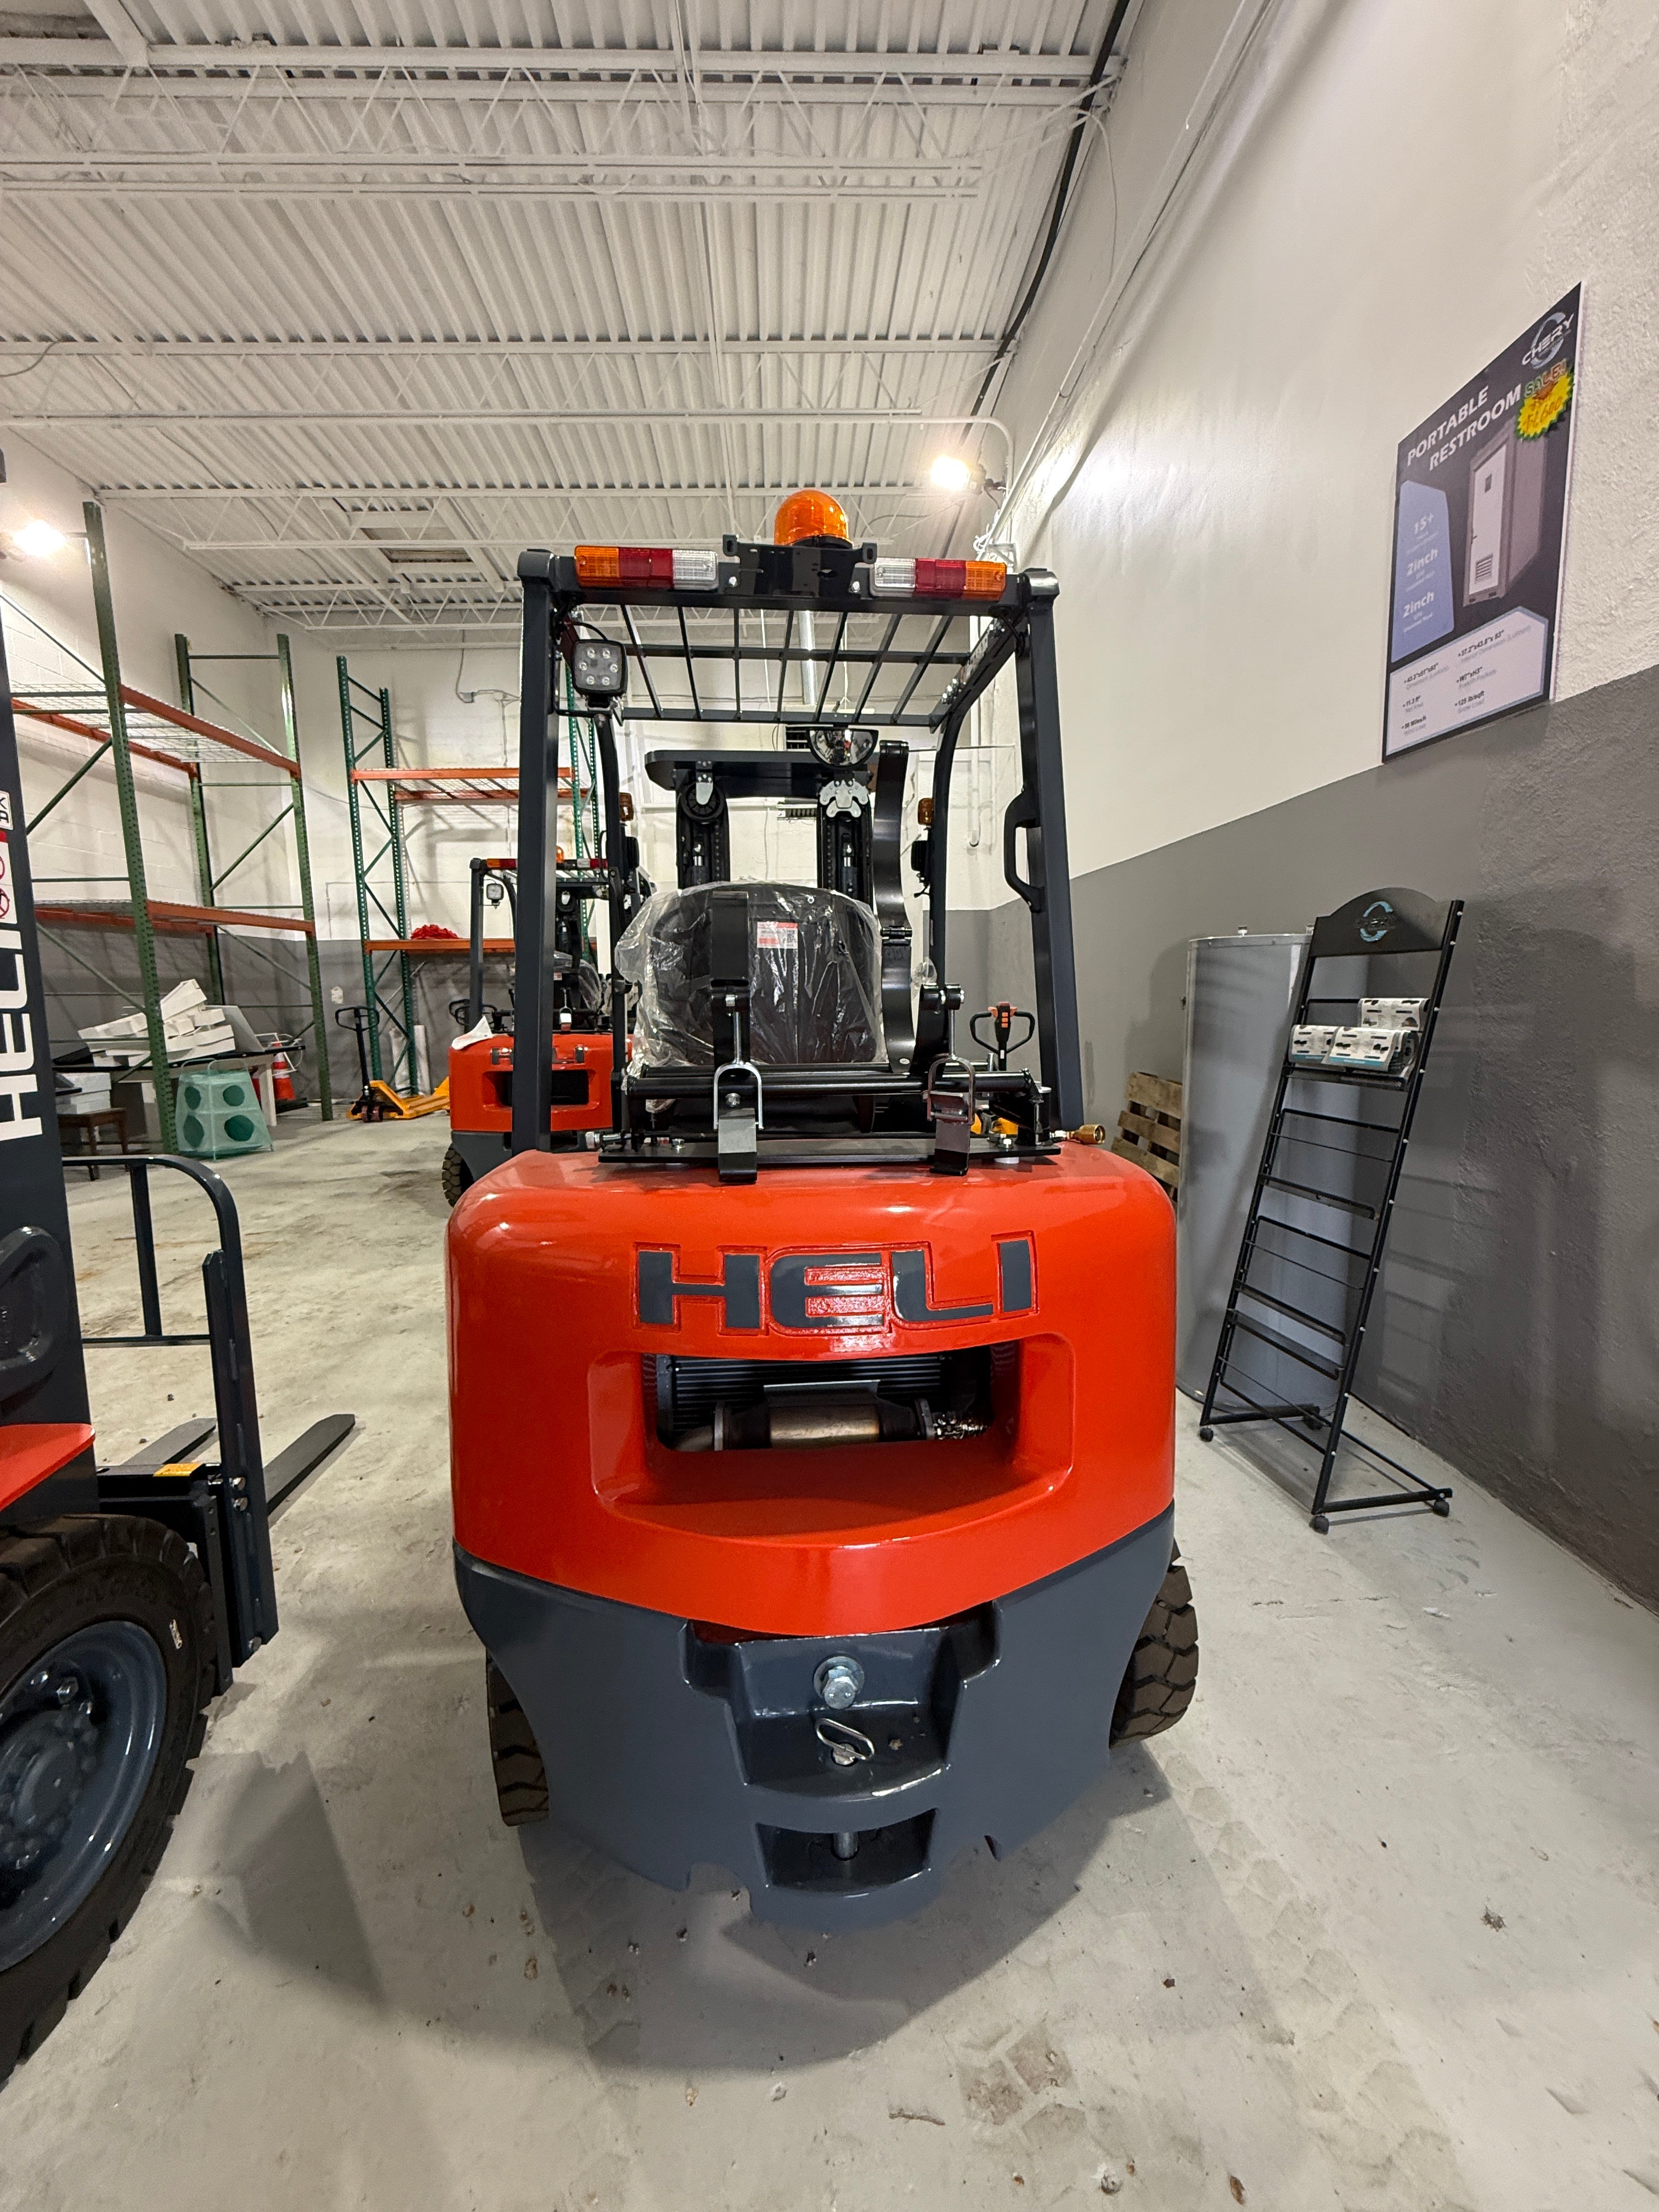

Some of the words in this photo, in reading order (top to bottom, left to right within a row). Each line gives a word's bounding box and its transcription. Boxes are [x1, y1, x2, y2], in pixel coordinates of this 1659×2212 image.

[1522, 312, 1574, 365] CHERY
[1408, 385, 1488, 466] PORTABLE
[1430, 383, 1521, 471] RESTROOM
[1406, 548, 1438, 577] 2inch
[1403, 591, 1435, 618] 2inch
[492, 1047, 585, 1065] HLI
[636, 1238, 1034, 1330] HELI
